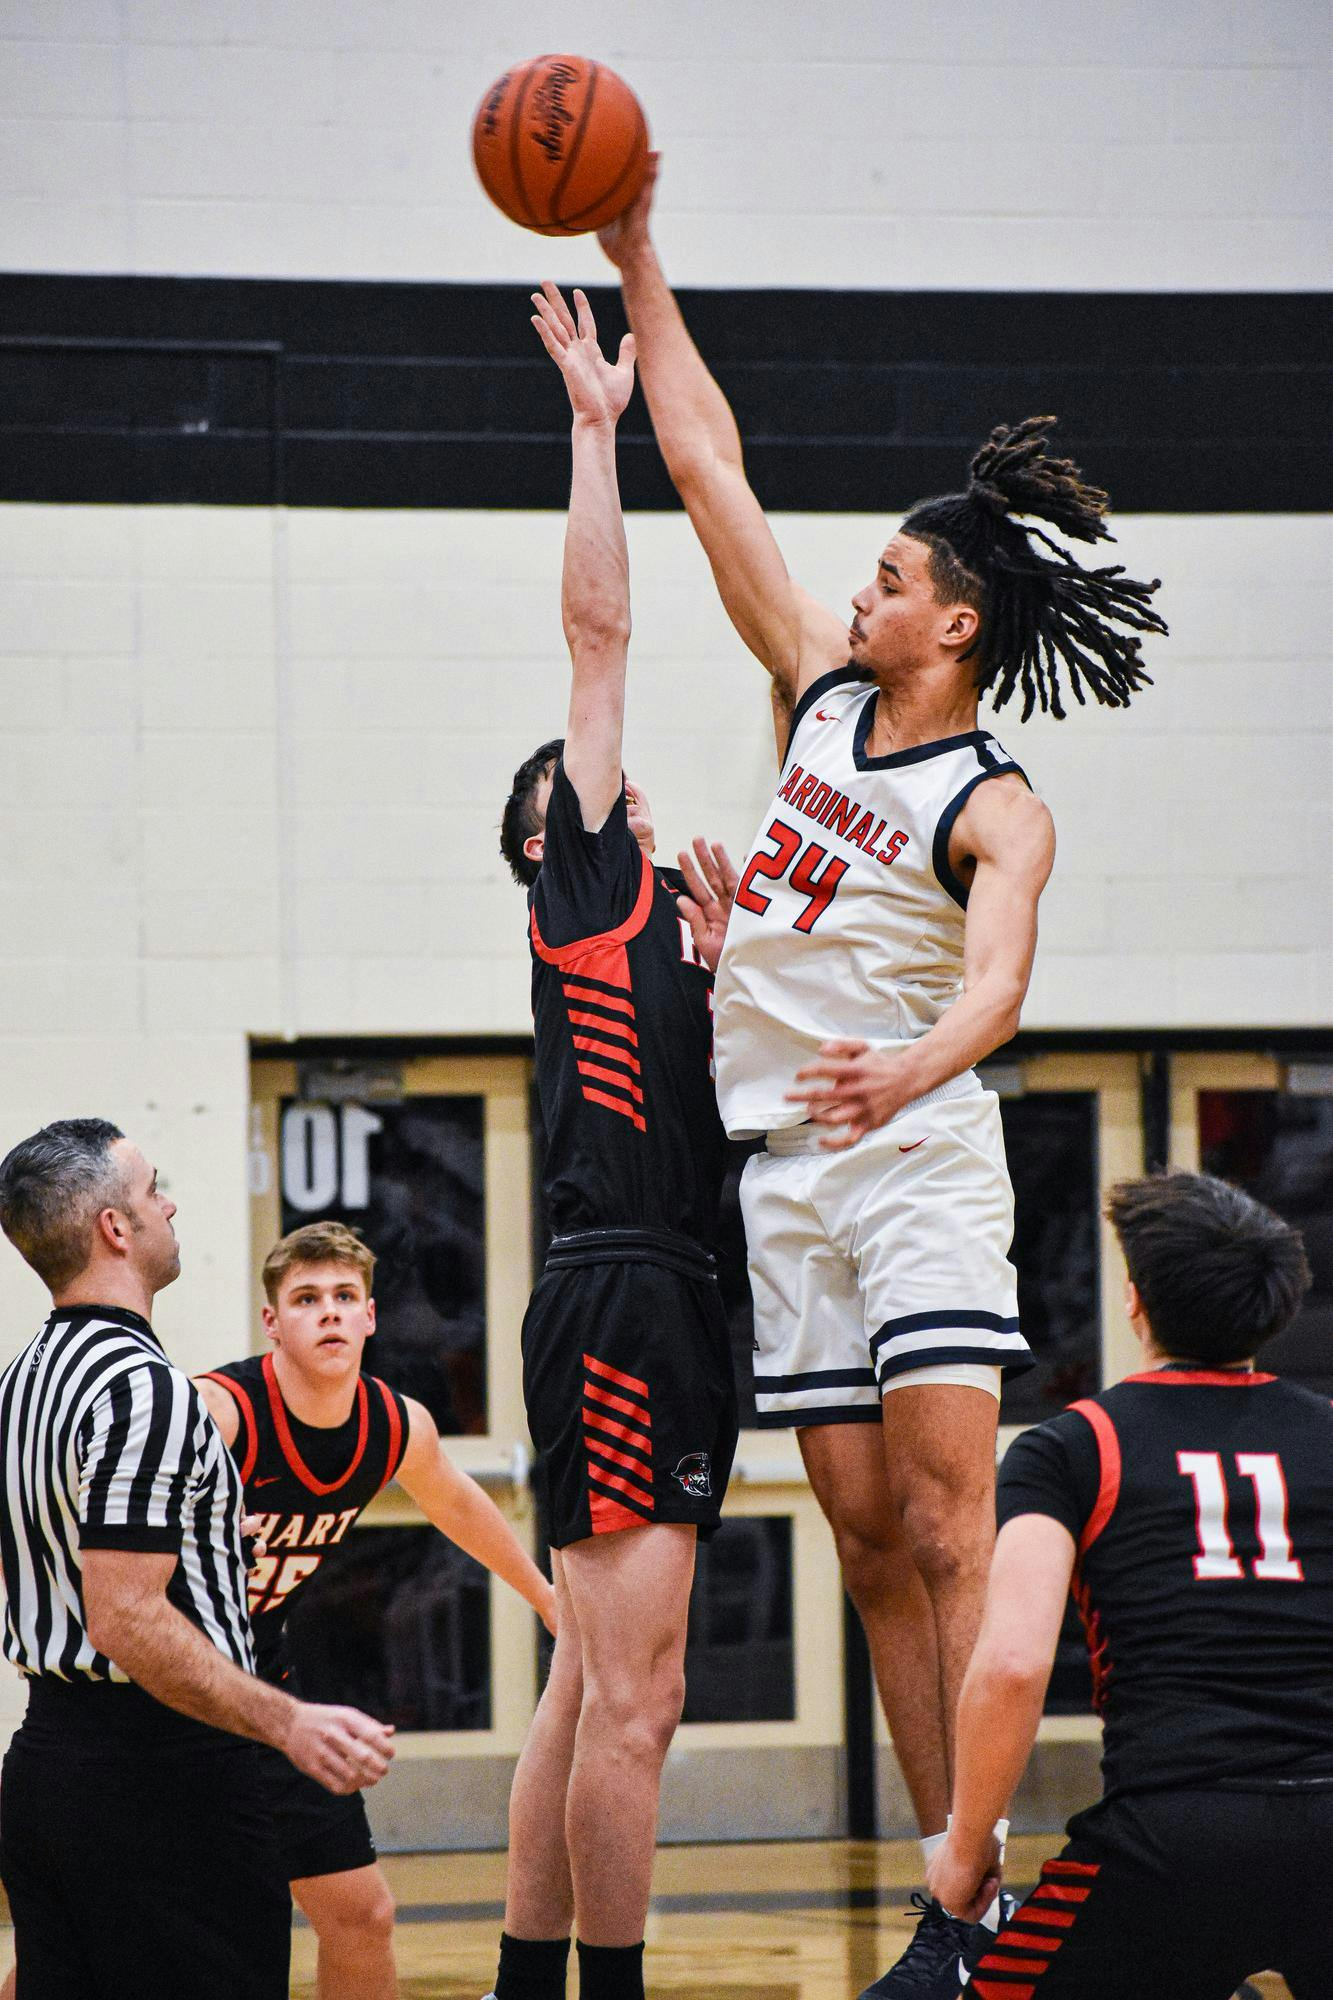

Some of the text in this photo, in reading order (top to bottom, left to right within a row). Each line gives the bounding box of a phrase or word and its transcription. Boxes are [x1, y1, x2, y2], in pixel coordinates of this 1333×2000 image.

[776, 763, 910, 867] ARDINALS
[734, 817, 851, 935] 24
[1174, 1449, 1305, 1582] 11
